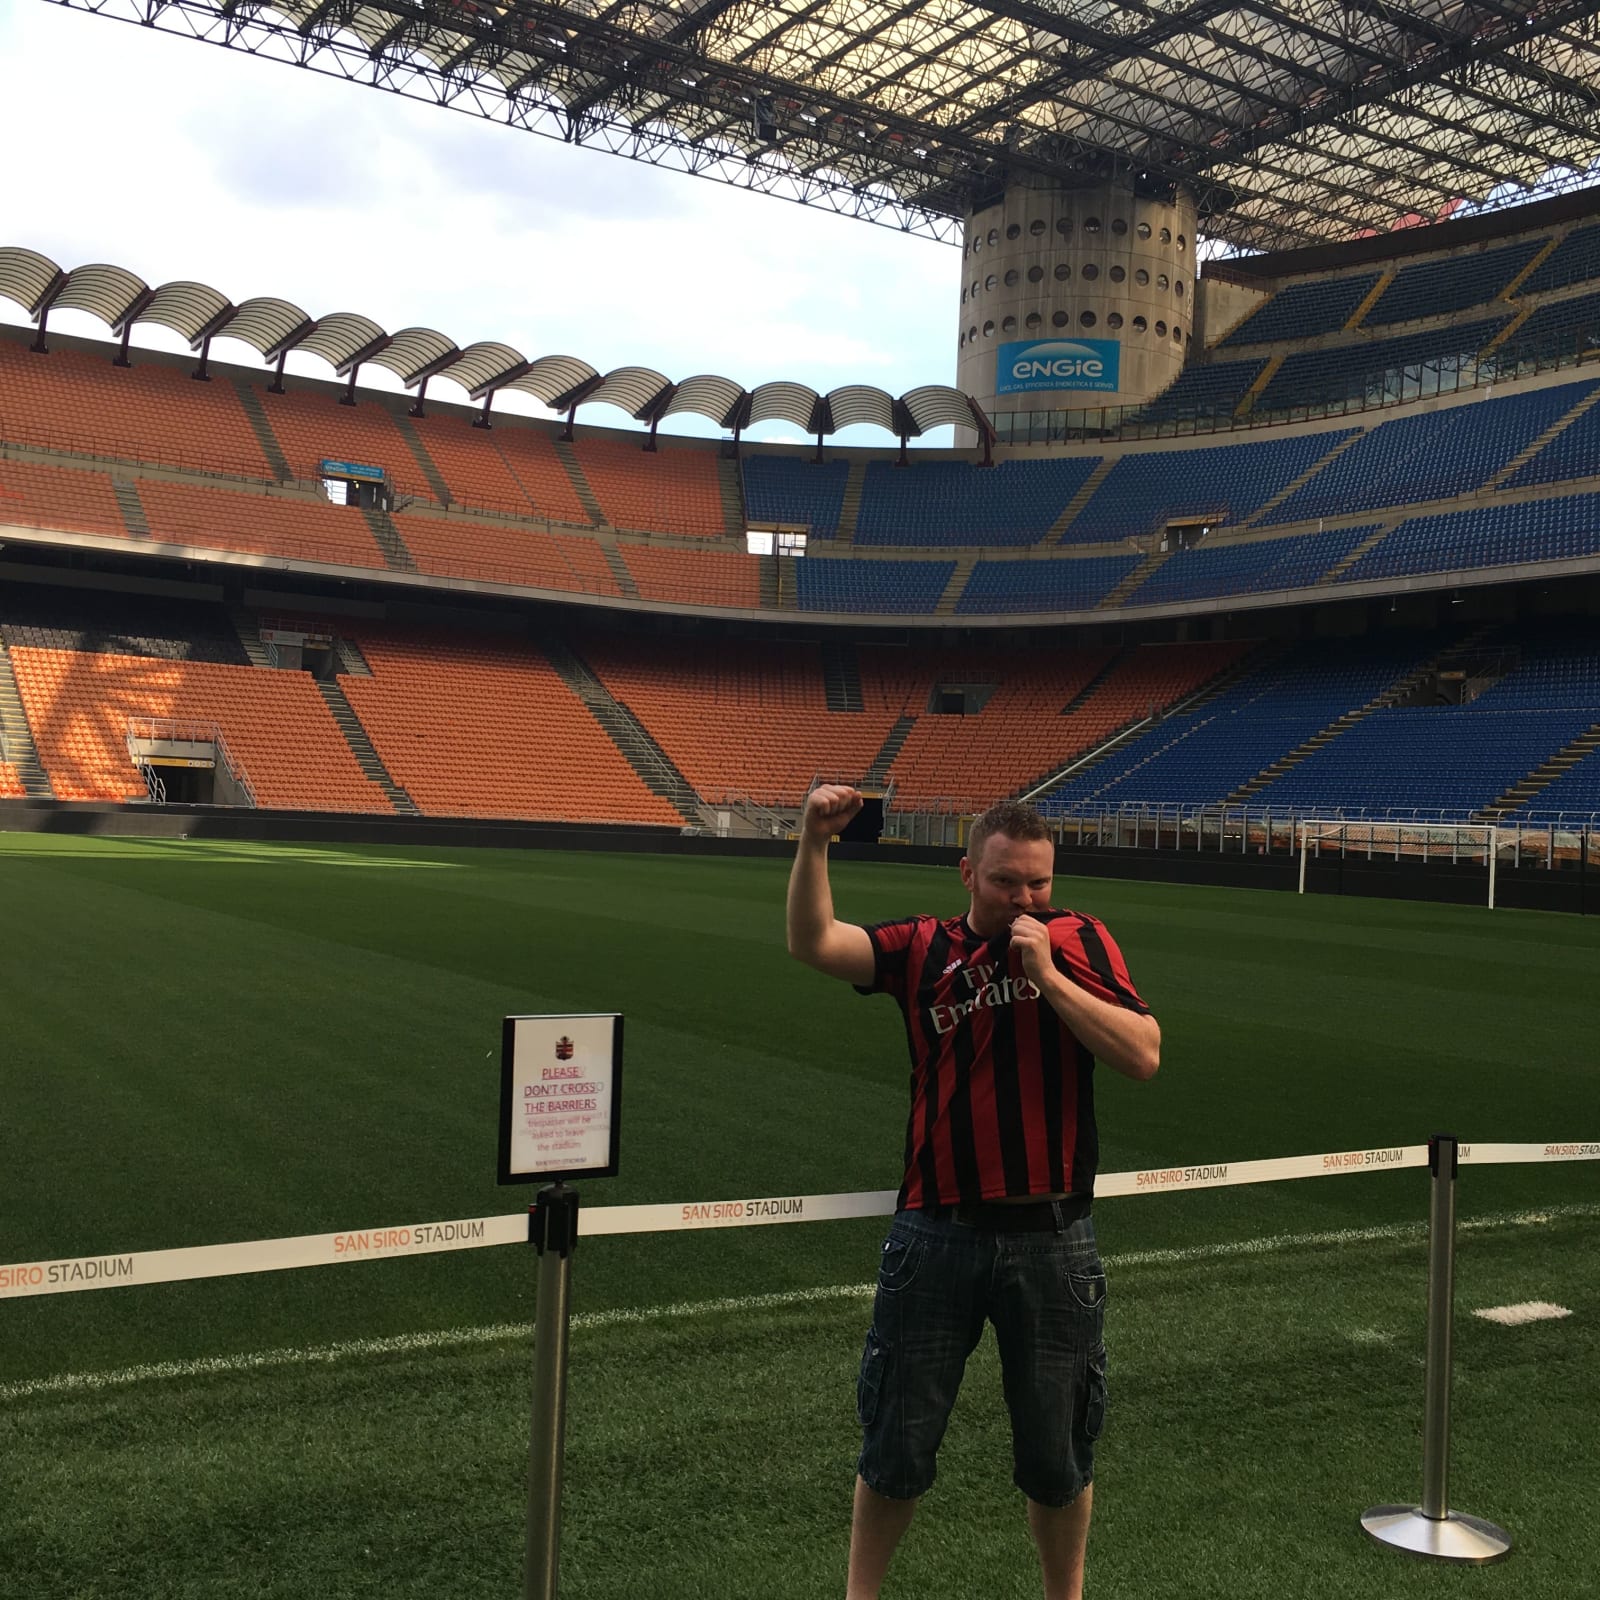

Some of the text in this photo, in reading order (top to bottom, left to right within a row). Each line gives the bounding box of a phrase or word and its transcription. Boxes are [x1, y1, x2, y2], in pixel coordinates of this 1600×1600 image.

[542, 1066, 580, 1079] PLEASE
[524, 1082, 596, 1097] DON'T CROSS
[525, 1099, 597, 1113] THE BARRIERS
[1323, 1156, 1342, 1168] SAN
[1343, 1153, 1363, 1166] SIRO
[1365, 1149, 1403, 1164] STADIUM
[1579, 1145, 1600, 1155] STAD
[1137, 1172, 1158, 1185] SAN
[1160, 1170, 1182, 1183] SIRO
[1184, 1166, 1227, 1181] STADIUM
[682, 1205, 711, 1220] SAN
[713, 1203, 743, 1218] SIRO
[746, 1199, 803, 1216] STADIUM
[334, 1233, 369, 1253] SAN
[373, 1229, 410, 1249] SIRO
[414, 1221, 484, 1244] STADIUM
[0, 1266, 43, 1288] SIRO
[48, 1257, 133, 1283] STADIUM
